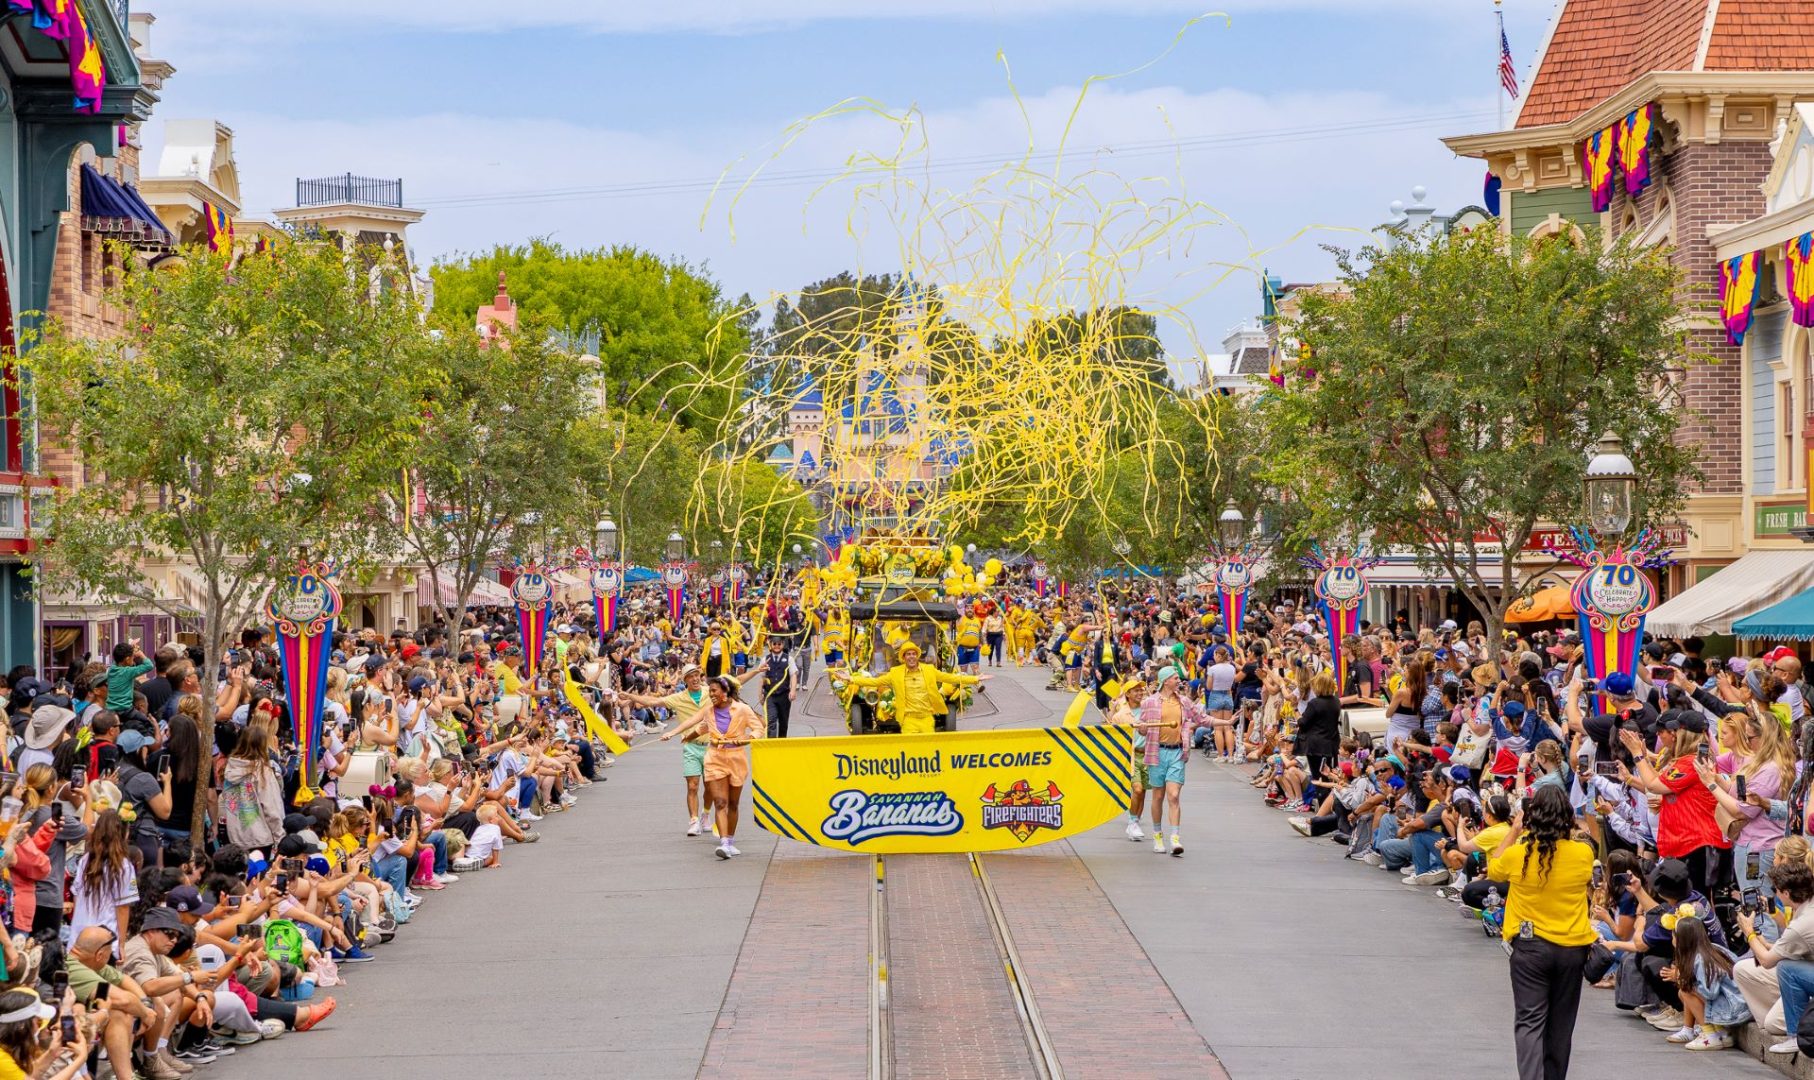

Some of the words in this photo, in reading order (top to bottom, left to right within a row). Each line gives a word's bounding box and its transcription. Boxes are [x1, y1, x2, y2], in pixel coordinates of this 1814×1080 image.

[1765, 513, 1788, 528] FRESH
[598, 568, 613, 578] 70
[1227, 562, 1244, 573] 70
[1333, 566, 1356, 580] 70
[523, 573, 542, 585] 70
[1601, 564, 1636, 586] 70
[287, 575, 317, 594] 70
[1600, 588, 1634, 597] CELEBRATE
[1606, 595, 1627, 603] HAPPY
[832, 750, 942, 781] Disneyland
[951, 751, 1053, 769] WELCOMES
[869, 793, 943, 805] SAVANNAH
[821, 790, 960, 841] Bananas
[983, 804, 1062, 827] FIREFIGHTERS
